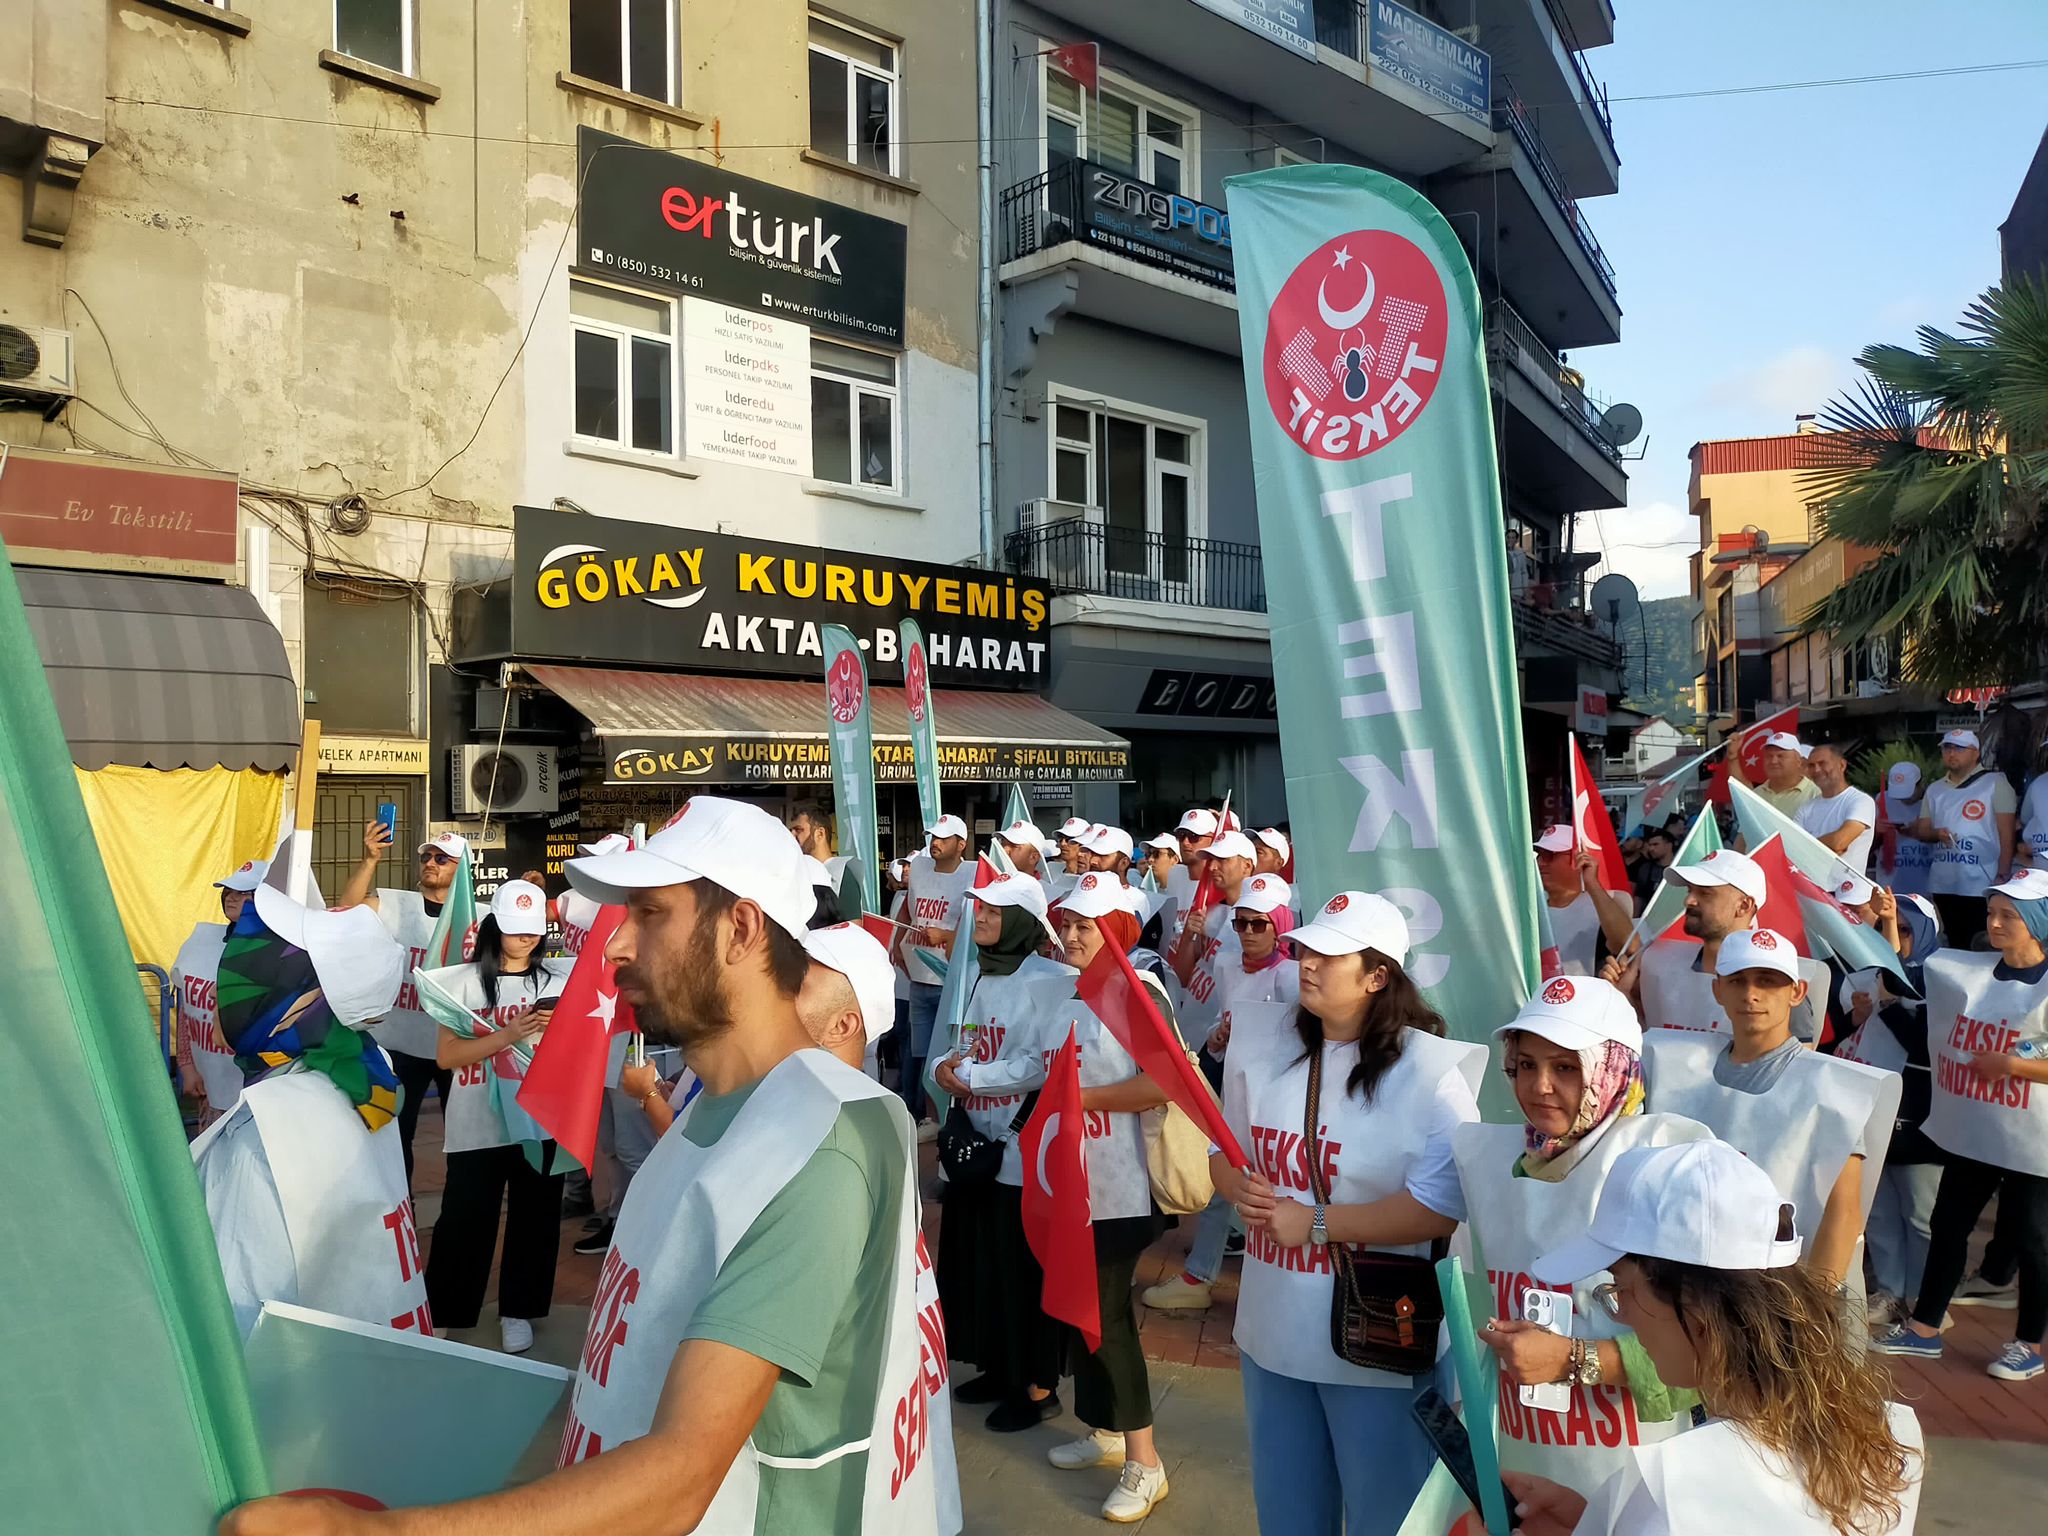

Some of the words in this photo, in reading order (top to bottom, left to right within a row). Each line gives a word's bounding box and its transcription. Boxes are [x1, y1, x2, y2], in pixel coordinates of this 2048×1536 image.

[1244, 9, 1266, 28] 0532
[1268, 22, 1283, 36] 169
[1285, 32, 1295, 43] 14
[1297, 38, 1308, 49] 60
[1378, 2, 1432, 47] MADEN
[1436, 35, 1482, 75] EMLAK
[1378, 56, 1399, 75] 222
[1402, 69, 1416, 84] 06
[1419, 79, 1431, 93] 12
[661, 186, 842, 275] ertürk
[1097, 230, 1108, 242] 222
[606, 253, 614, 266] 0
[617, 256, 647, 276] (850)
[650, 265, 671, 281] 532
[675, 271, 688, 285] 14
[691, 276, 704, 288] 61
[729, 246, 757, 263] bilişim
[767, 257, 802, 276] güvenlik
[803, 266, 842, 286] sistemleri
[774, 297, 897, 337] www.erturkbilisim.com.tr
[755, 337, 784, 350] YAZILIMI
[705, 365, 741, 381] PERSONEL
[764, 378, 793, 391] YAZILIMI
[695, 402, 714, 414] YURT
[775, 418, 803, 431] YAZILIMI
[702, 442, 746, 457] YEMEKHANE
[768, 454, 798, 466] YAZILIMI
[64, 500, 94, 522] Ev
[109, 504, 193, 531] Tekstili
[537, 547, 704, 609] GÖKAY
[739, 552, 1047, 632] KURUYEMİŞ
[702, 612, 830, 657] AKTA
[876, 627, 1046, 674] BHARAT
[359, 750, 423, 763] APARTMANI
[537, 751, 550, 793] arçelik
[614, 746, 715, 779] GÖKAY
[727, 743, 831, 763] KURUYEMİ
[871, 746, 914, 763] KTAR
[938, 748, 997, 764] AHARAT
[745, 765, 778, 779] FORM
[880, 763, 917, 778] ÜRÜNL
[985, 763, 1021, 780] YAĞLAR
[1078, 768, 1124, 780] MACUNLAR
[549, 810, 580, 829] BAHARAT
[651, 805, 679, 815] KAHV
[546, 834, 564, 842] ANLIK
[565, 833, 579, 841] TAZE
[546, 844, 575, 857] KURU
[915, 896, 949, 920] TEKSİF
[1947, 1013, 2021, 1054] TEKSİF
